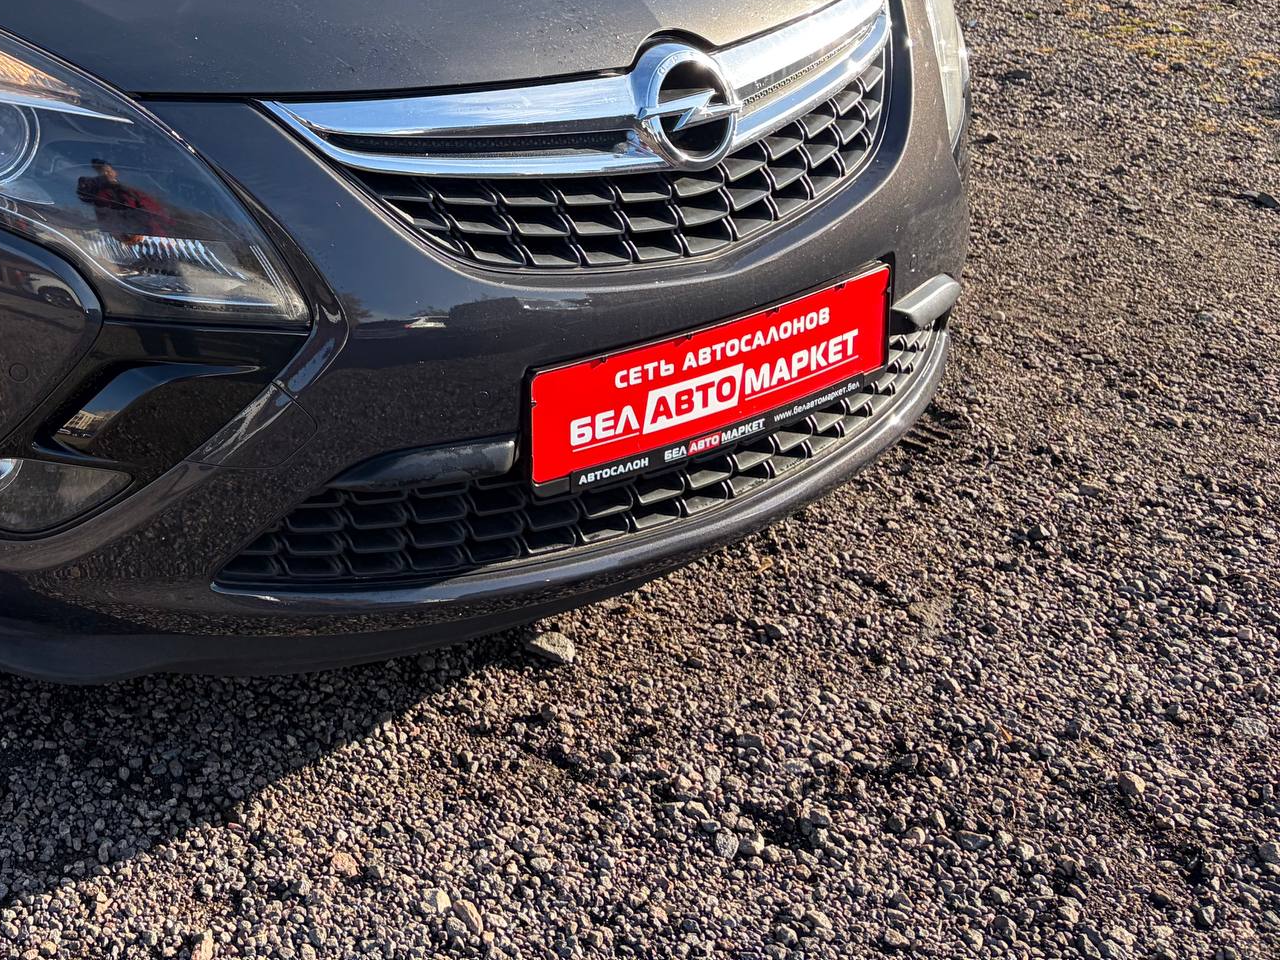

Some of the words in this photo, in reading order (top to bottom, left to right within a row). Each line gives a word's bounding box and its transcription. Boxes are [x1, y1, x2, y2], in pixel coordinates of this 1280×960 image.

[614, 359, 675, 389] СЕТЬ
[681, 306, 831, 372] АВТОСАЛОНОВ
[578, 457, 649, 486] АВТОСАЛОН
